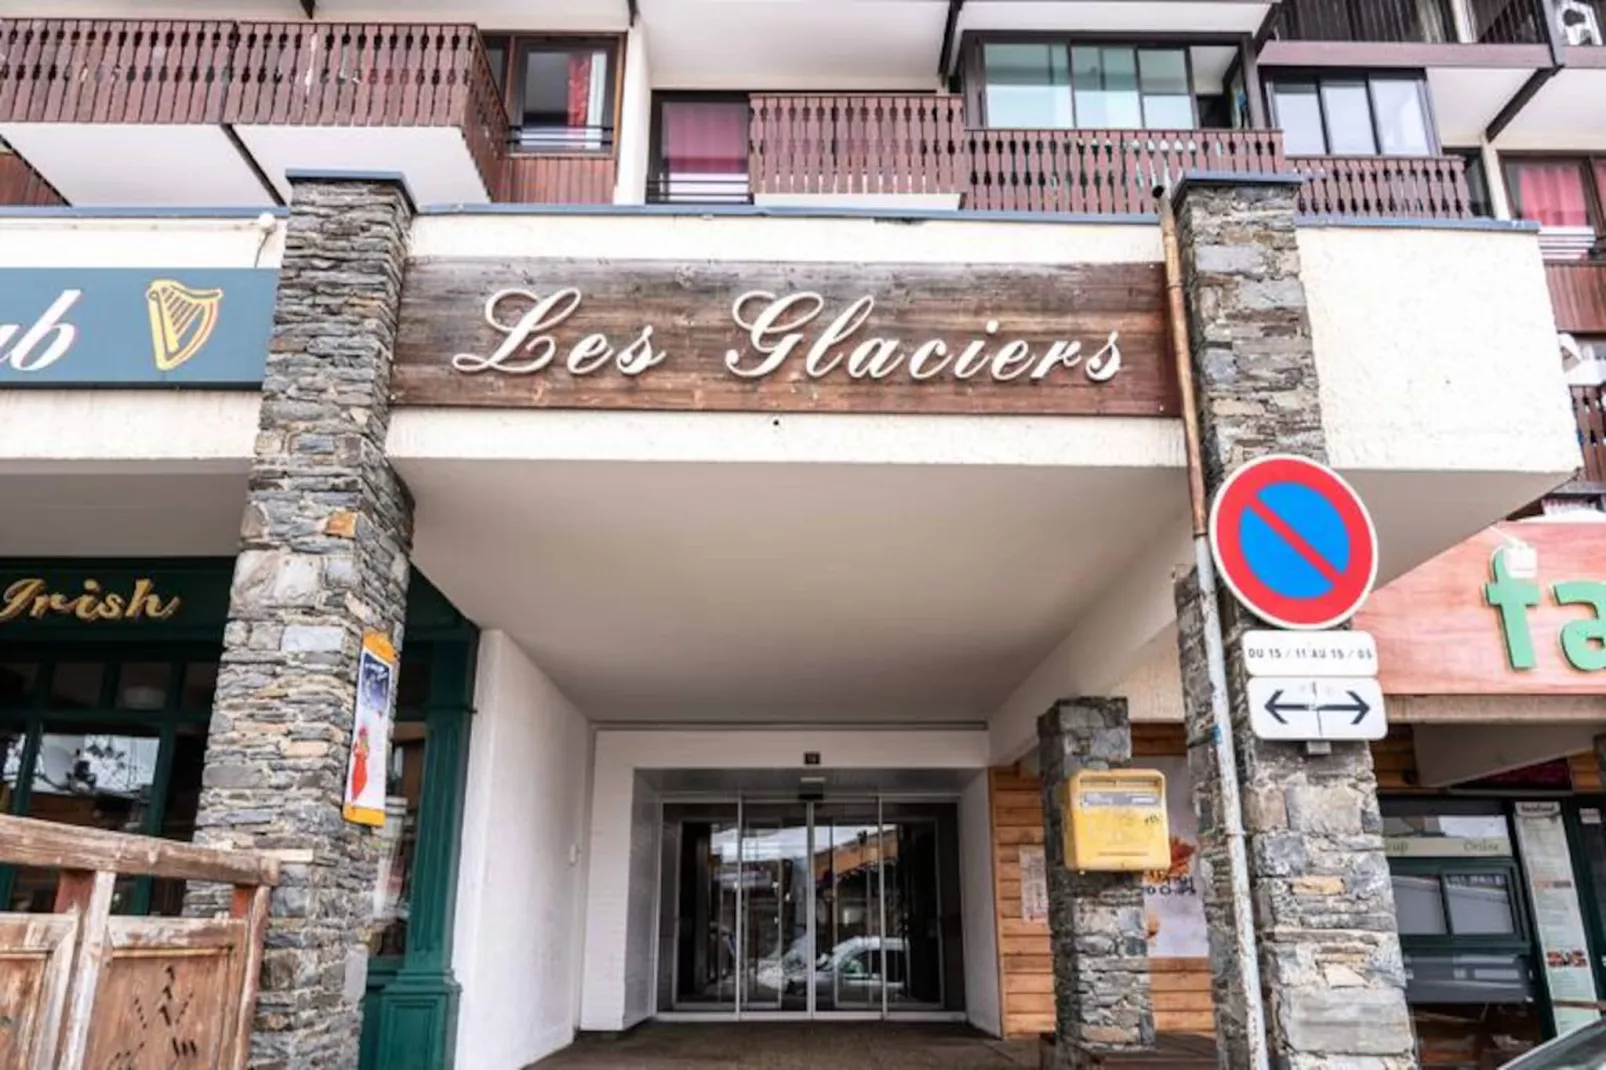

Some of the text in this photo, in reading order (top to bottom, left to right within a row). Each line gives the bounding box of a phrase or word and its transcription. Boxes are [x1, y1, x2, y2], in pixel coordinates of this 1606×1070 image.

[452, 287, 1123, 381] Les Glaciers
[0, 578, 181, 622] Irish
[1311, 648, 1326, 658] AU
